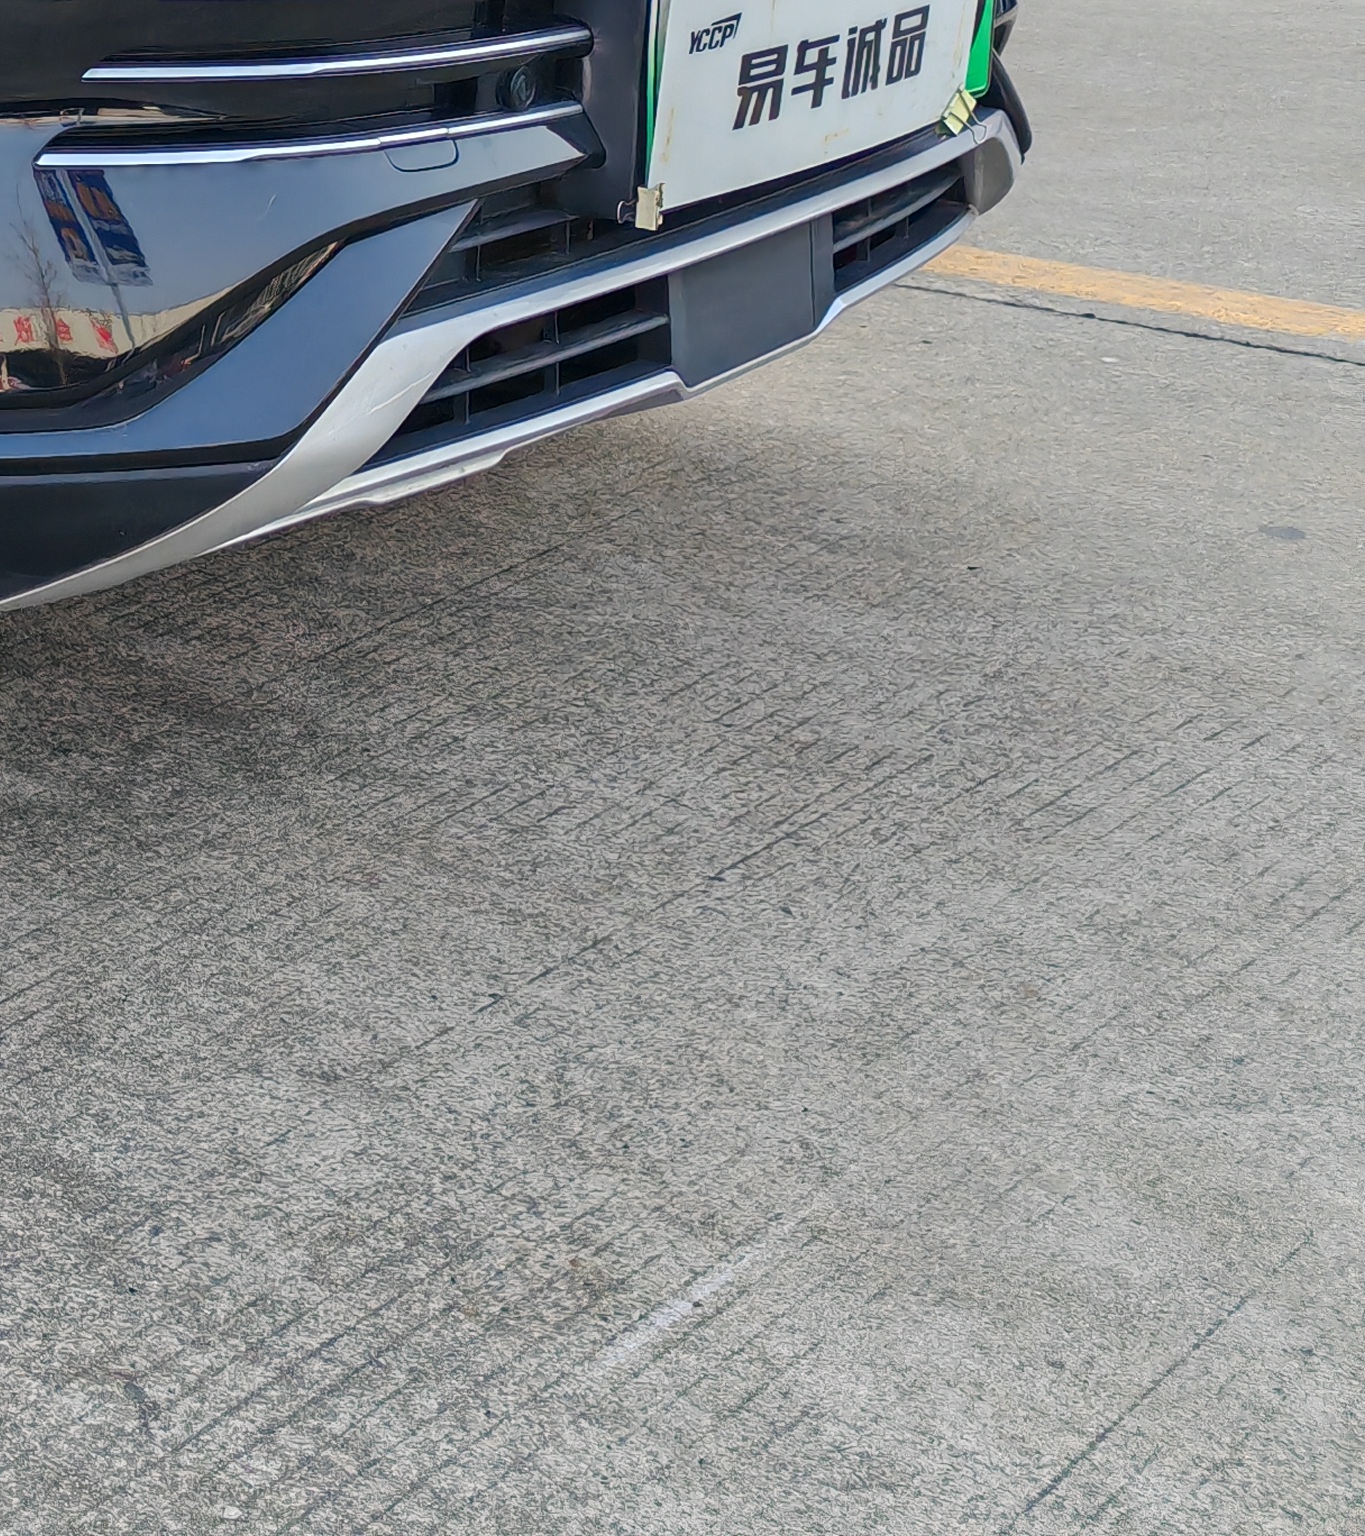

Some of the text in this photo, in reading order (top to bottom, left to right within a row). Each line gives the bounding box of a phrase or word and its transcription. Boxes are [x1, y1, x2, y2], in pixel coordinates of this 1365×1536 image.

[689, 20, 737, 54] YCCP
[732, 4, 930, 130] 易车诚品
